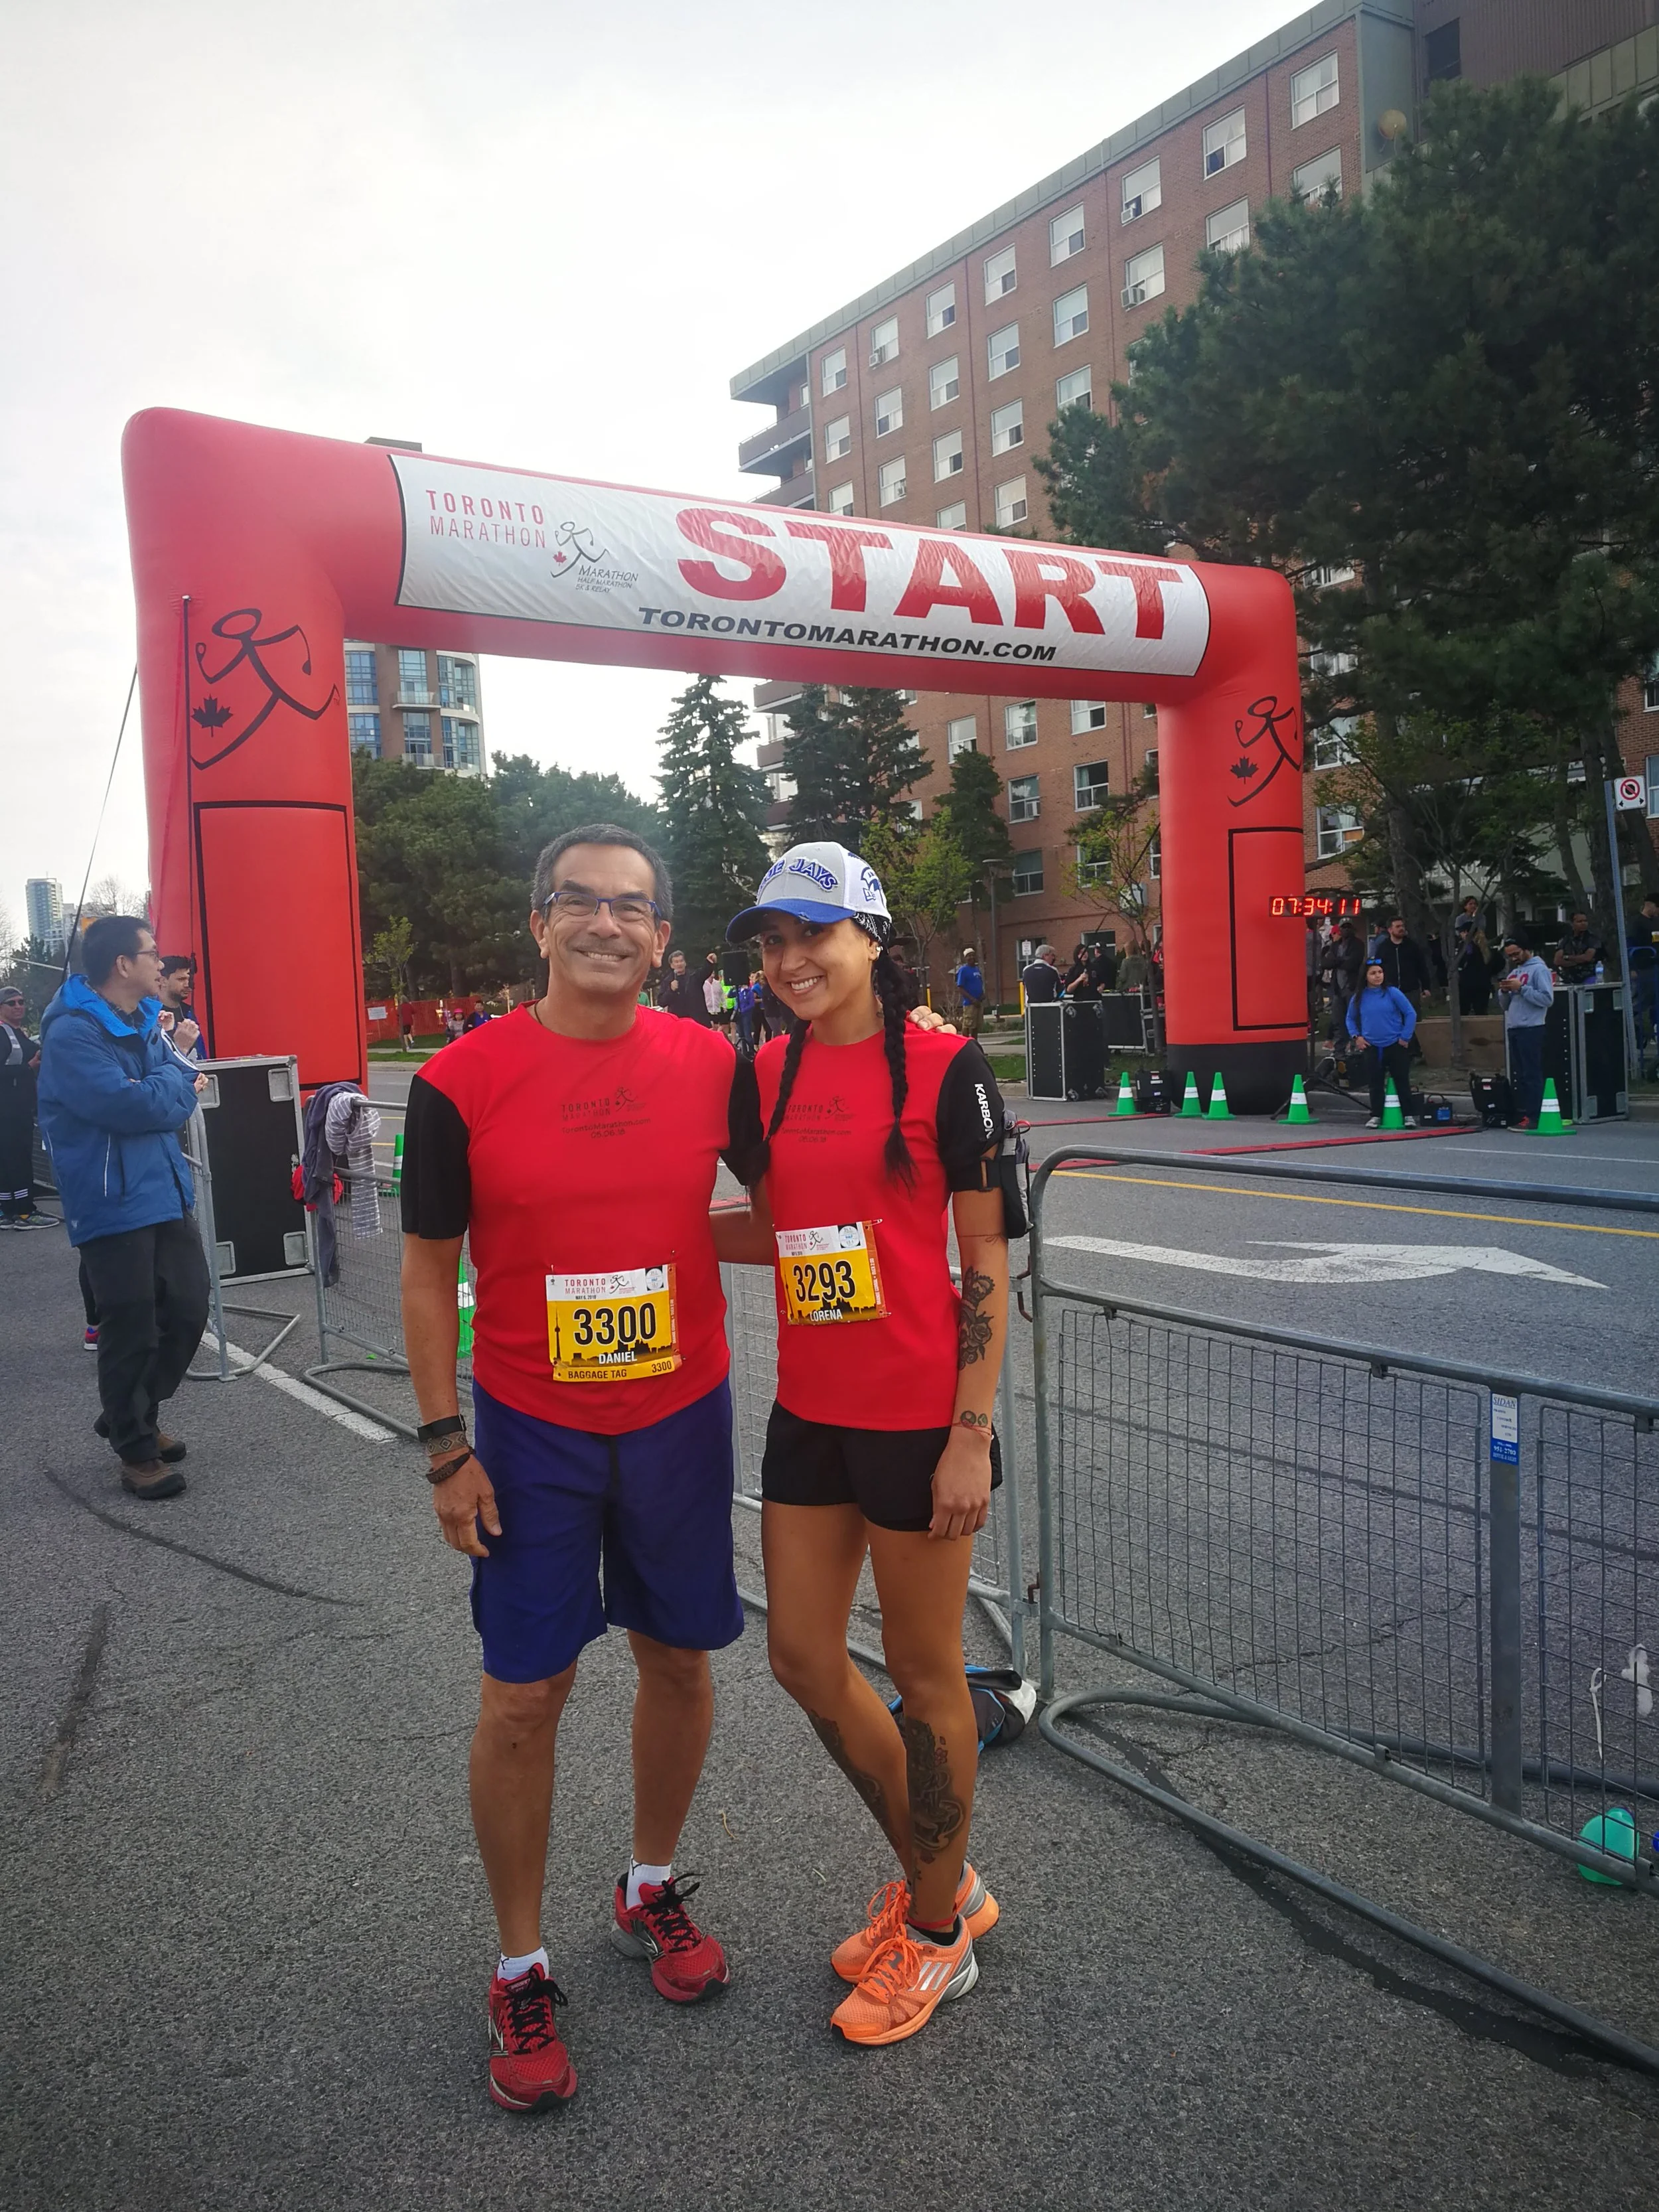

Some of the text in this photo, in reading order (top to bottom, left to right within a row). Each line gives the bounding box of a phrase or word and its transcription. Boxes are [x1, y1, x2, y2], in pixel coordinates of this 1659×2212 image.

[426, 490, 545, 525] TORONTO
[430, 516, 546, 549] MARATHON
[579, 565, 638, 581] MARATHON
[675, 508, 1183, 640] START
[596, 579, 632, 589] MARATHON
[638, 607, 1057, 662] TORONTOMARATHON.COM
[788, 858, 838, 891] JAYS
[1272, 898, 1359, 915] 07:34:11
[561, 1098, 610, 1113] TORONTO
[974, 1083, 994, 1140] KARBON
[784, 1234, 806, 1243] TORONTO
[565, 1278, 607, 1287] TORONTO
[793, 1260, 856, 1302] 3293
[573, 1302, 656, 1345] 3300
[810, 1309, 843, 1322] LORENA
[599, 1351, 638, 1364] DANIEL
[568, 1360, 672, 1379] BAGGAGE TAG 3300
[1493, 1396, 1516, 1408] SIDAN
